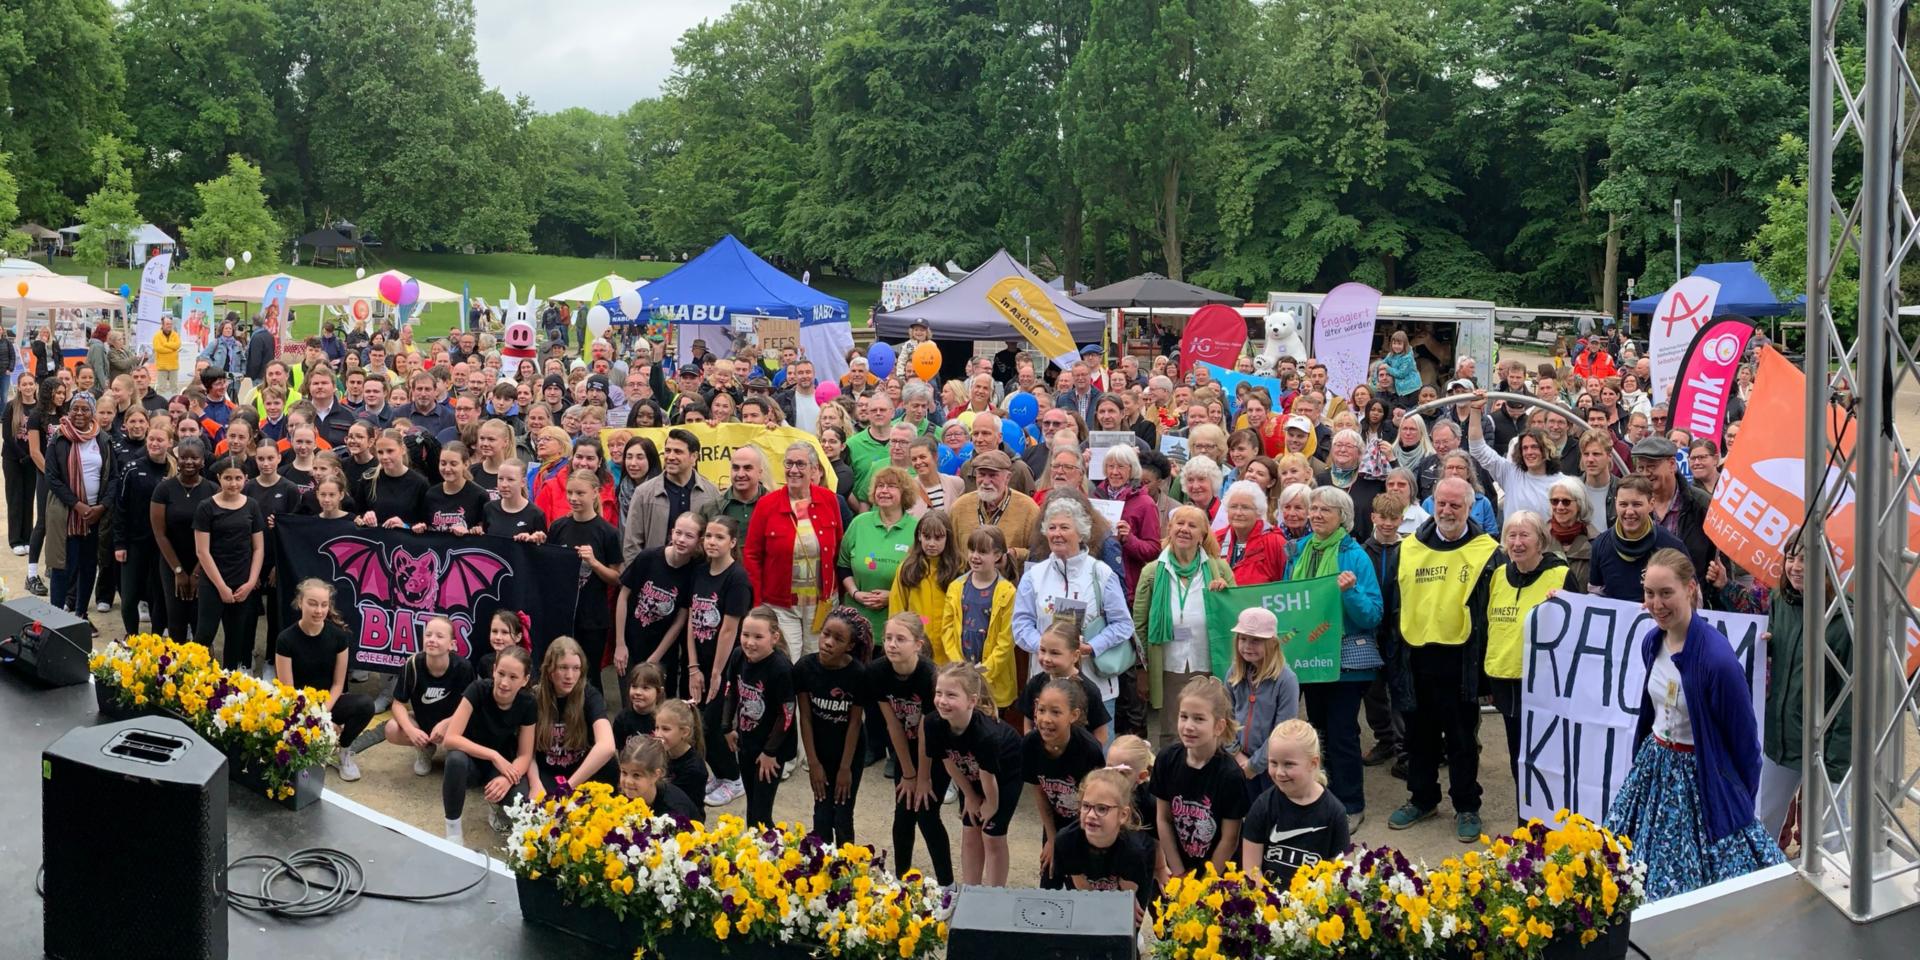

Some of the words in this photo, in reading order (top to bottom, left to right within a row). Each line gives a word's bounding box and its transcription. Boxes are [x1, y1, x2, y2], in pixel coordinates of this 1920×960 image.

[660, 304, 726, 321] NABU
[813, 304, 834, 321] NABU
[1000, 297, 1010, 308] in
[1010, 305, 1039, 337] Aachen
[1321, 308, 1371, 329] Engagiert
[1344, 320, 1372, 333] werden
[1688, 372, 1726, 441] unk
[696, 445, 742, 462] REAT
[1415, 566, 1449, 578] AMNESTY
[1751, 549, 1784, 578] SIC
[1491, 606, 1519, 616] AMNESTY
[356, 650, 408, 667] CHEERLEA
[1294, 656, 1333, 669] Aachen
[1528, 599, 1758, 716] RACM
[425, 687, 445, 699] NIKE
[1524, 710, 1615, 822] KILL
[1267, 846, 1319, 869] AIR
